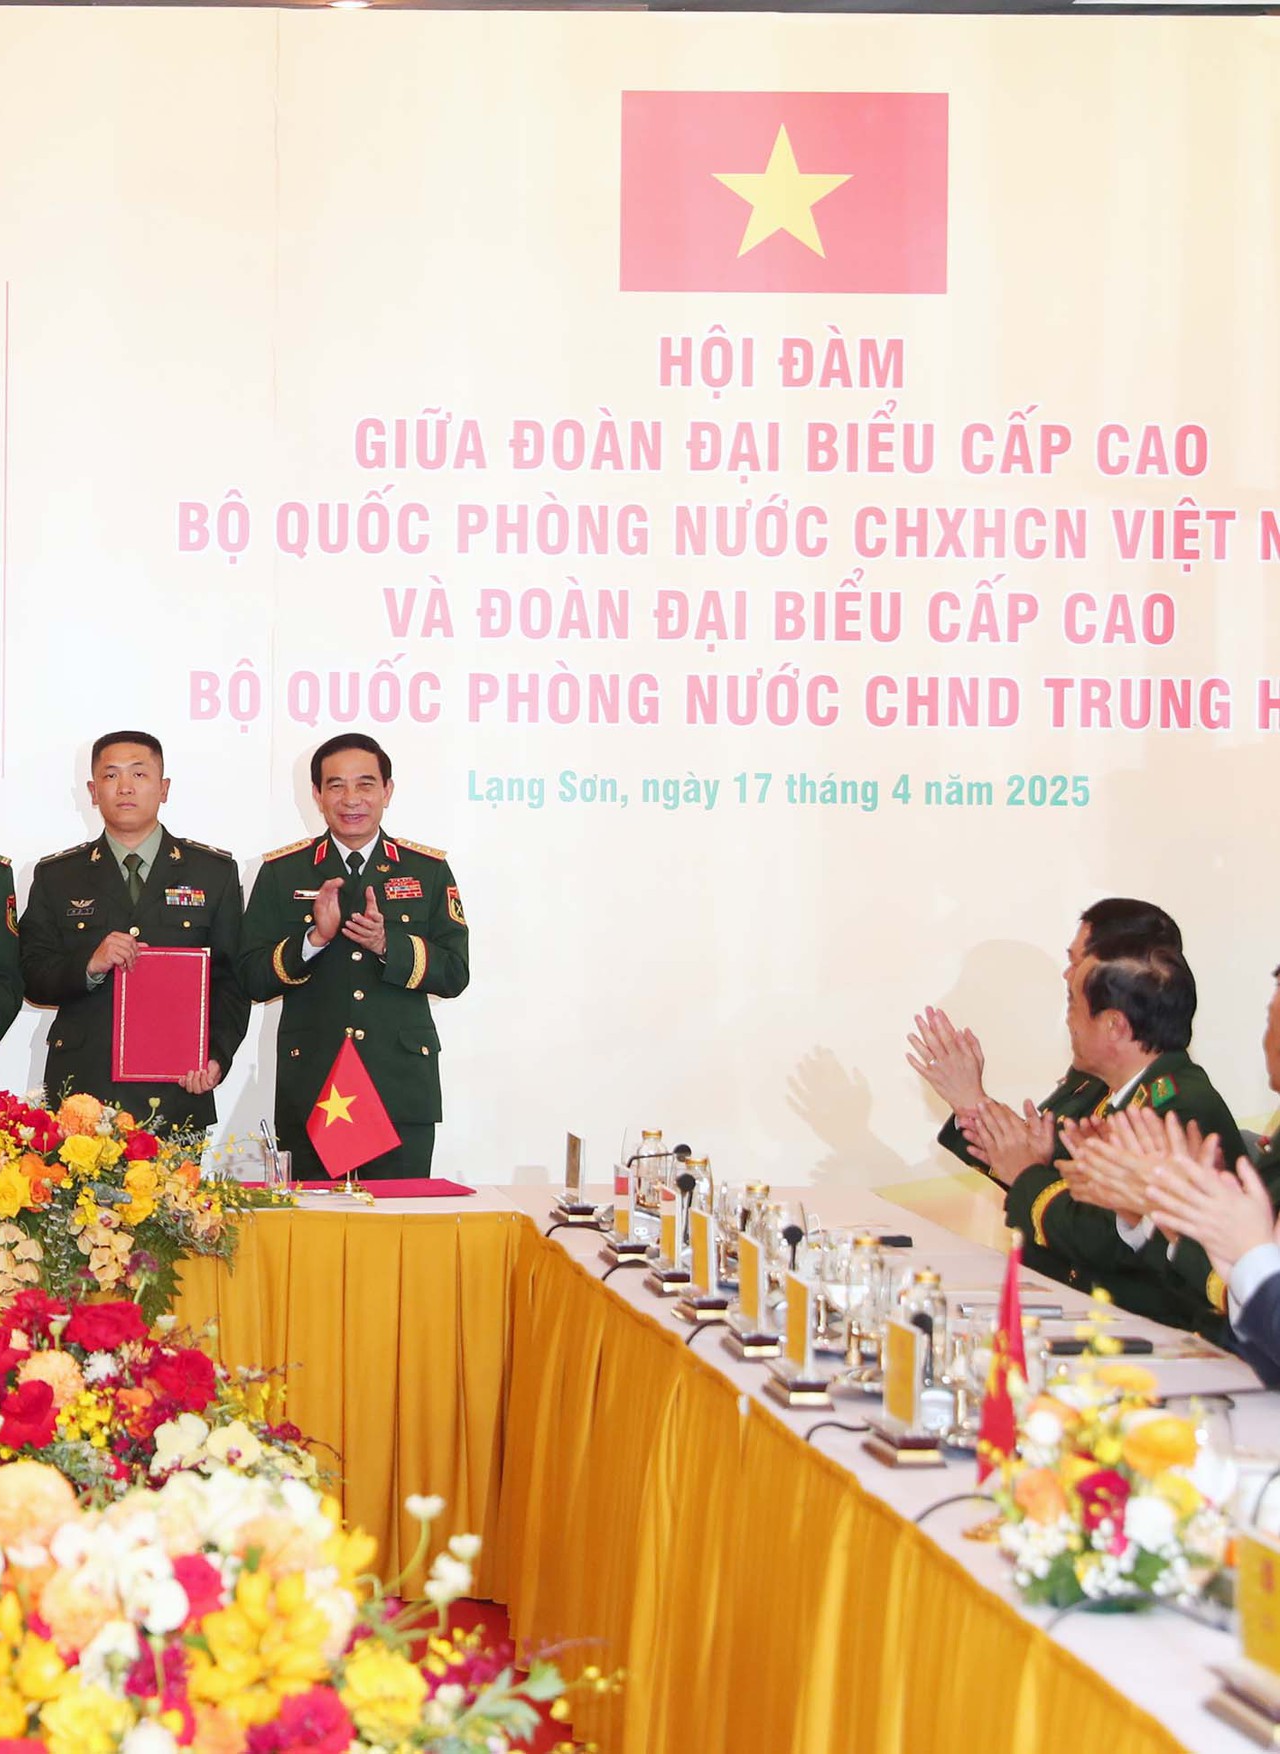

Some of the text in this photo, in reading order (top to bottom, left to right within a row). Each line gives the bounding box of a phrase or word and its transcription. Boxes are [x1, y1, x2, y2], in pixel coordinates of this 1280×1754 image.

[660, 325, 904, 399] HỘI ĐÀM
[355, 400, 1209, 484] GIỮA ĐOÀN ĐẠI BIỂU CẤP CAO
[178, 489, 250, 564] BỘ
[276, 484, 430, 558] QUỐC
[457, 492, 648, 556] PHÒNG
[675, 493, 828, 558] NƯỚC
[853, 506, 1087, 559] CHXHCN
[1111, 496, 1237, 573] VIỆT
[383, 568, 1176, 653] VÀ ĐOÀN ĐẠI BIỂU CẤP CAO
[189, 658, 261, 734] BỘ
[287, 653, 441, 728] QUỐC
[468, 660, 660, 726] PHÒNG
[685, 662, 840, 728] NƯỚC
[865, 675, 1020, 728] CHND
[1043, 677, 1231, 730] TRUNG
[468, 769, 1091, 813] Lạng Sơn, ngày 17 tháng 4 năm 2025
